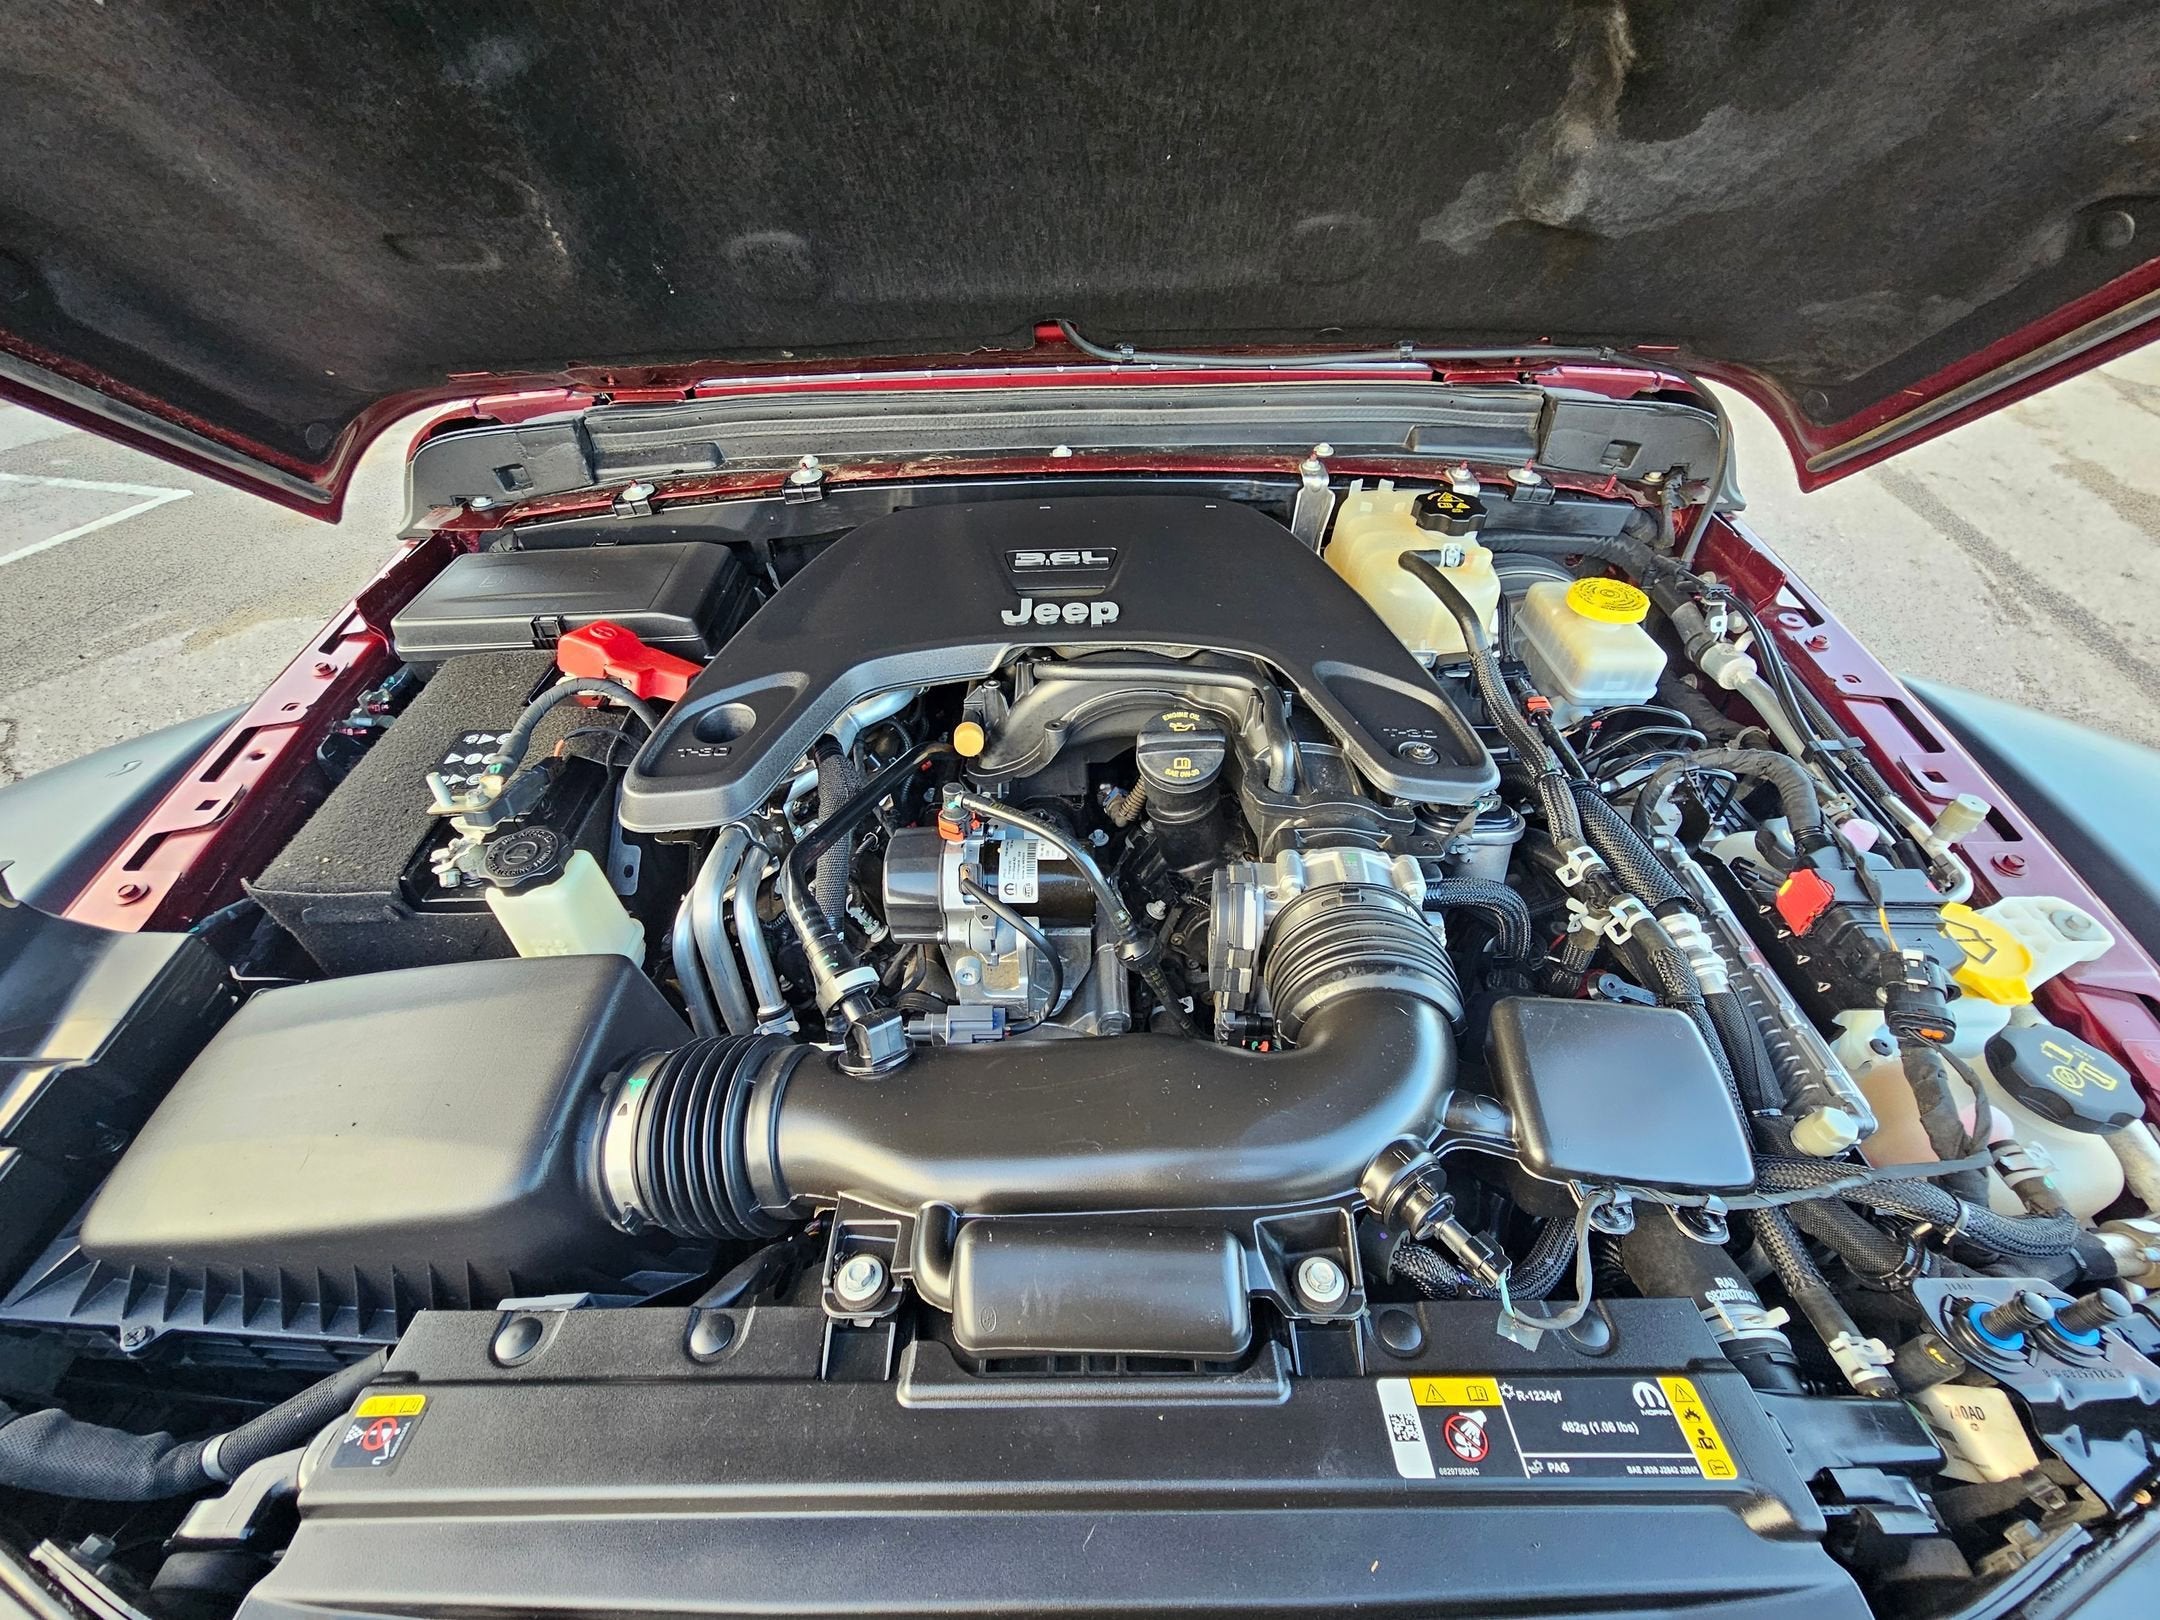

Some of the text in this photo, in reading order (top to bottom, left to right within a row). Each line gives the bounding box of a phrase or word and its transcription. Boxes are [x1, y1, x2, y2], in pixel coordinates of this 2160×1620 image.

[1015, 551, 1109, 566] 3.6L
[1001, 598, 1120, 628] Jeep
[1162, 711, 1200, 721] ENGINE OIL
[1165, 768, 1179, 777] SAE
[1714, 1277, 1739, 1289] RAD
[1516, 1390, 1562, 1404] R-1234yf
[1562, 1421, 1590, 1435] 482g
[1615, 1421, 1640, 1435] lbs)
[1547, 1462, 1570, 1473] PAG
[1626, 1465, 1643, 1475] SAE
